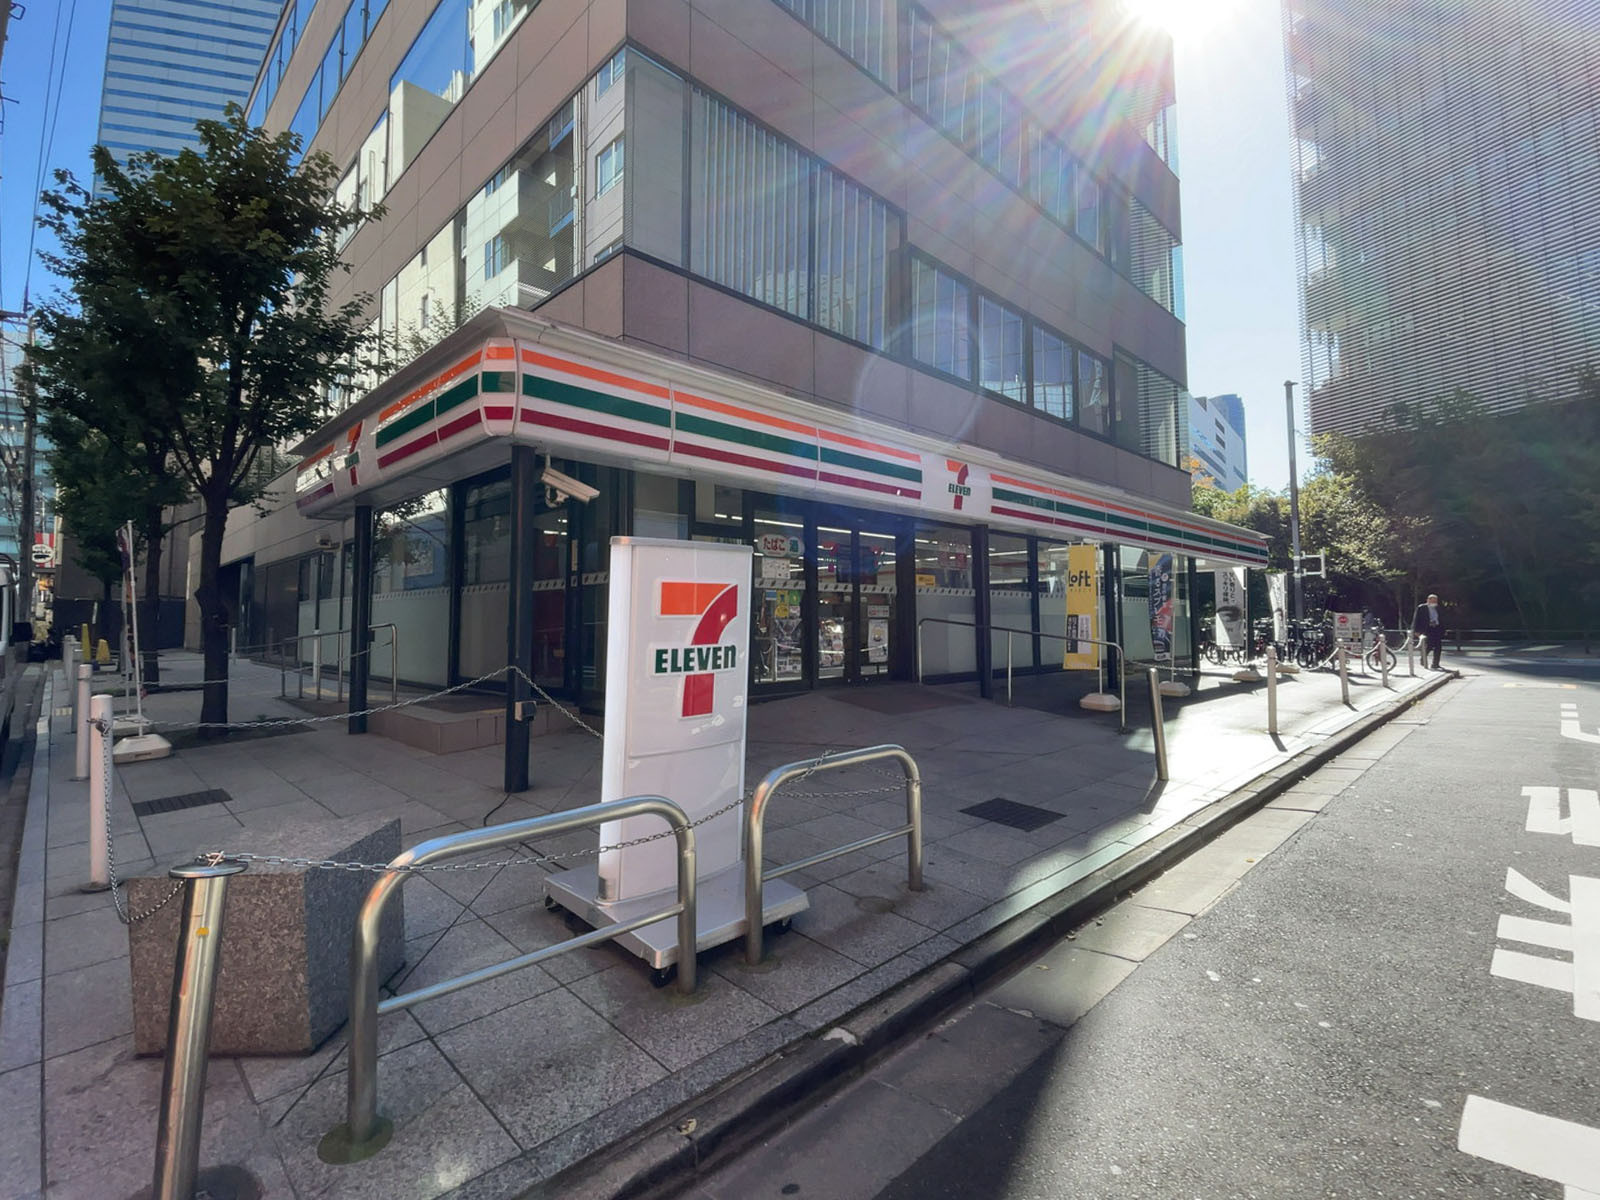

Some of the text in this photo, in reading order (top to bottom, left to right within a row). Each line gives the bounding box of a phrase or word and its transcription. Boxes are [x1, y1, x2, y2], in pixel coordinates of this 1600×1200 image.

[946, 459, 969, 510] 7
[763, 537, 786, 551] たばこ
[660, 581, 738, 717] 7
